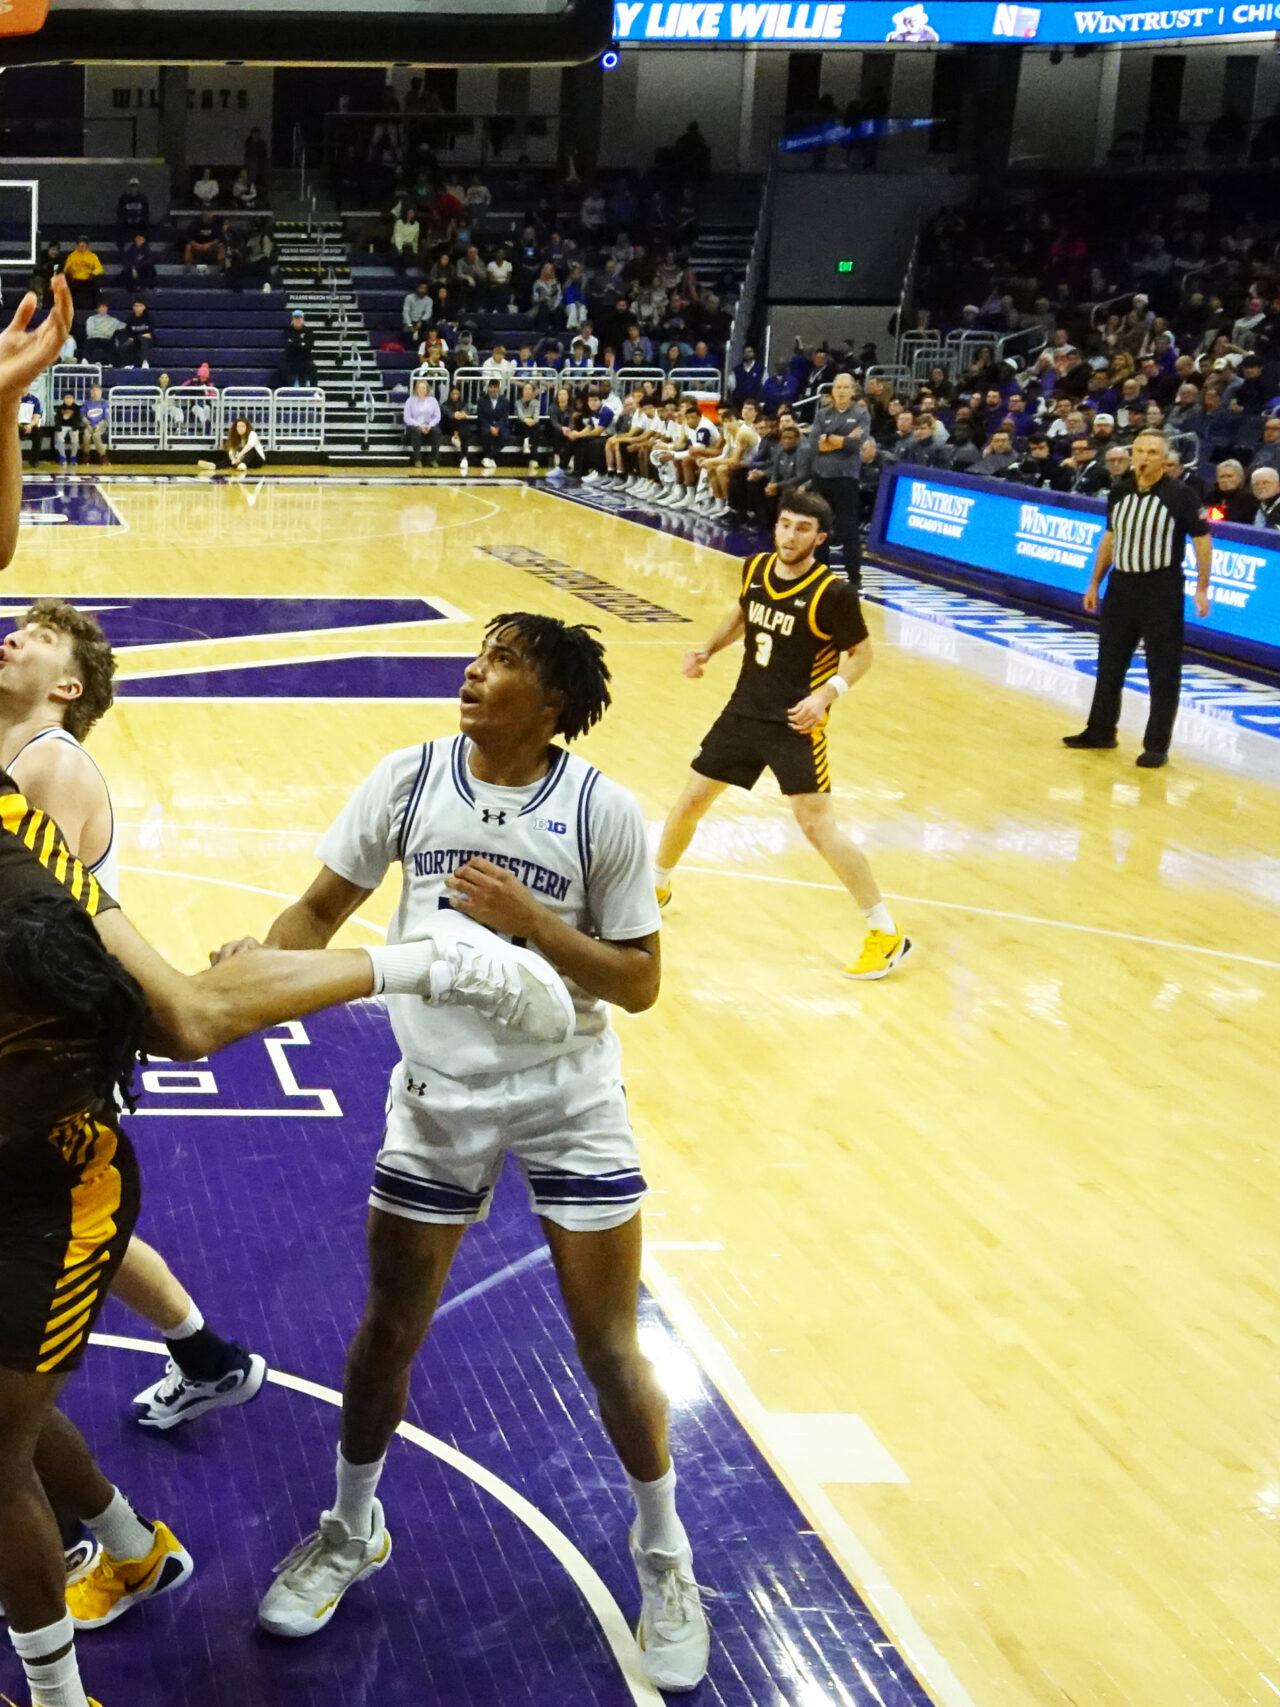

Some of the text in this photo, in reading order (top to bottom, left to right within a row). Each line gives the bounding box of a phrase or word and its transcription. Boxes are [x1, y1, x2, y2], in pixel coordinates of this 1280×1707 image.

[613, 3, 846, 38] Y LIKE WILLIE
[1074, 8, 1211, 33] WINTRUST
[112, 88, 248, 109] WILCATS
[911, 482, 974, 518] WINTRUST
[942, 524, 963, 538] BANK
[1020, 505, 1101, 545] WINTRUST
[1017, 541, 1088, 568] CHICAGO'S BANK
[748, 600, 795, 637] VALPO
[755, 631, 773, 667] 3
[534, 818, 567, 835] B1G
